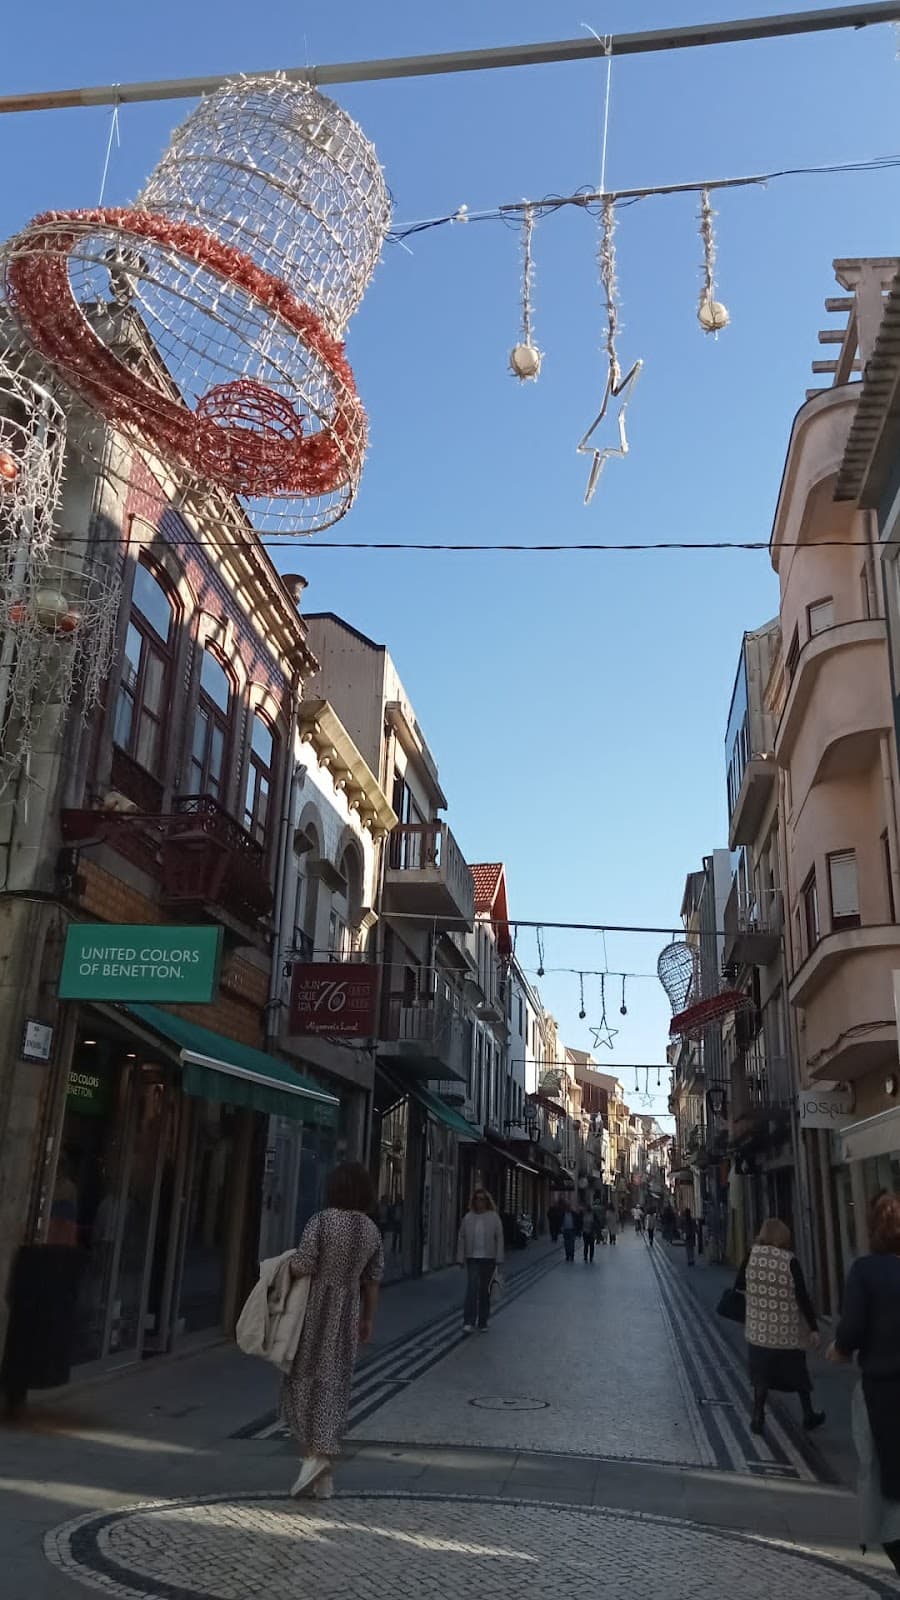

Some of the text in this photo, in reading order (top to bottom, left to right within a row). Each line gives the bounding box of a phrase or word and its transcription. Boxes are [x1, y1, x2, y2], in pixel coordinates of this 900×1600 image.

[81, 947, 200, 963] UNITED COLORS
[79, 963, 185, 979] OF BENETTON.
[314, 981, 349, 1012] 76
[79, 1073, 99, 1087] COLORS
